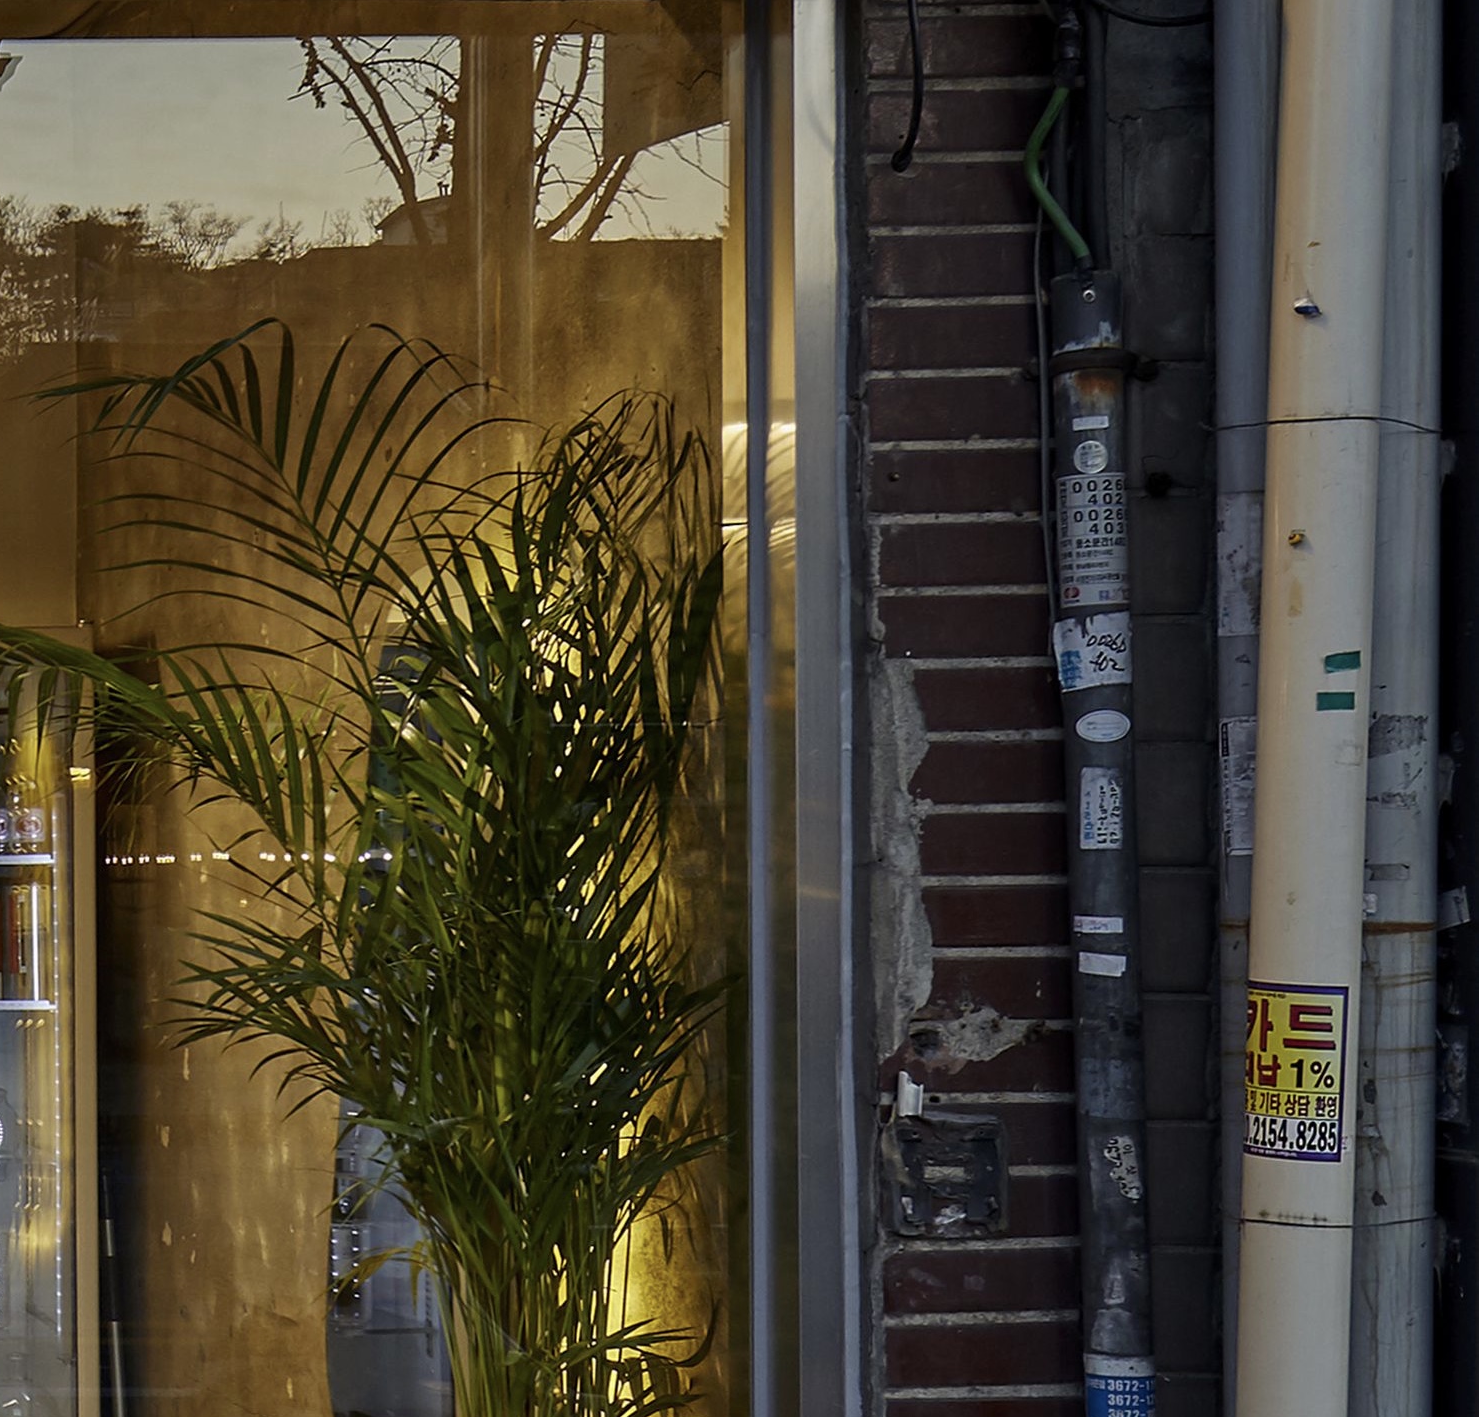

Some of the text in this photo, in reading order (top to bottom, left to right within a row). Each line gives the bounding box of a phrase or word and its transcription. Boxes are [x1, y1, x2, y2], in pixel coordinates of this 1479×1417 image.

[1087, 493, 1124, 506] 402
[1089, 522, 1125, 535] 403
[1290, 1058, 1335, 1090] 1%
[1258, 1092, 1282, 1115] 기타
[1284, 1095, 1311, 1118] 상담
[1314, 1096, 1338, 1119] 환영
